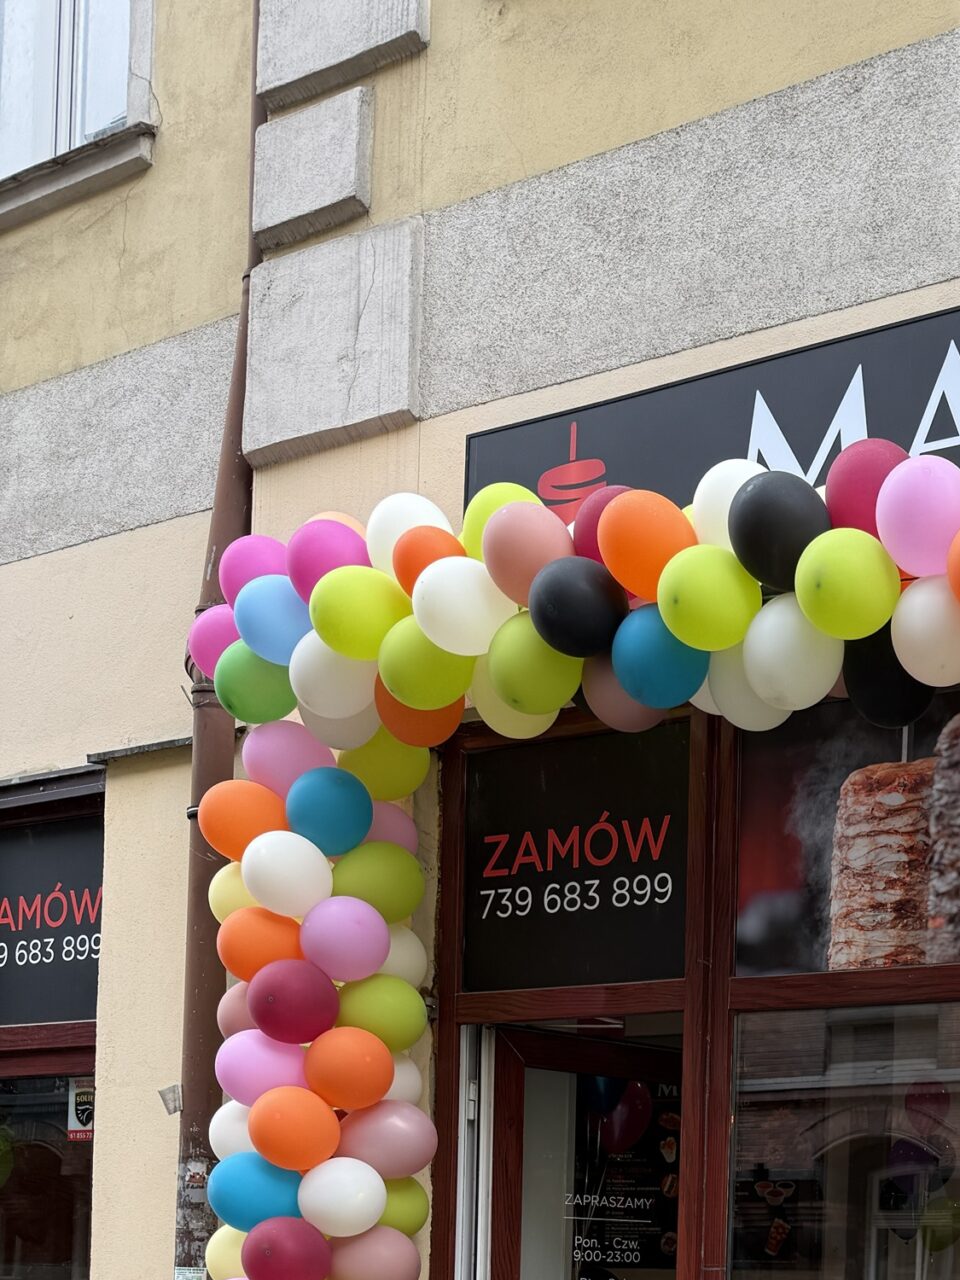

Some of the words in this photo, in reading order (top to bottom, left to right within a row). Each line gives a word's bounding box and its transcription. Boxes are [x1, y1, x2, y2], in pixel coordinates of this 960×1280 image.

[482, 810, 672, 878] ZAMÓW
[479, 886, 533, 920] 739
[543, 879, 601, 914] 683
[611, 872, 673, 908] 899
[15, 937, 55, 966] 683
[62, 933, 102, 961] 899
[564, 1193, 653, 1210] ZAPRASZAMY
[574, 1235, 601, 1249] Pon.
[613, 1237, 641, 1250] Czw.
[573, 1250, 641, 1263] 9:00-23:00
